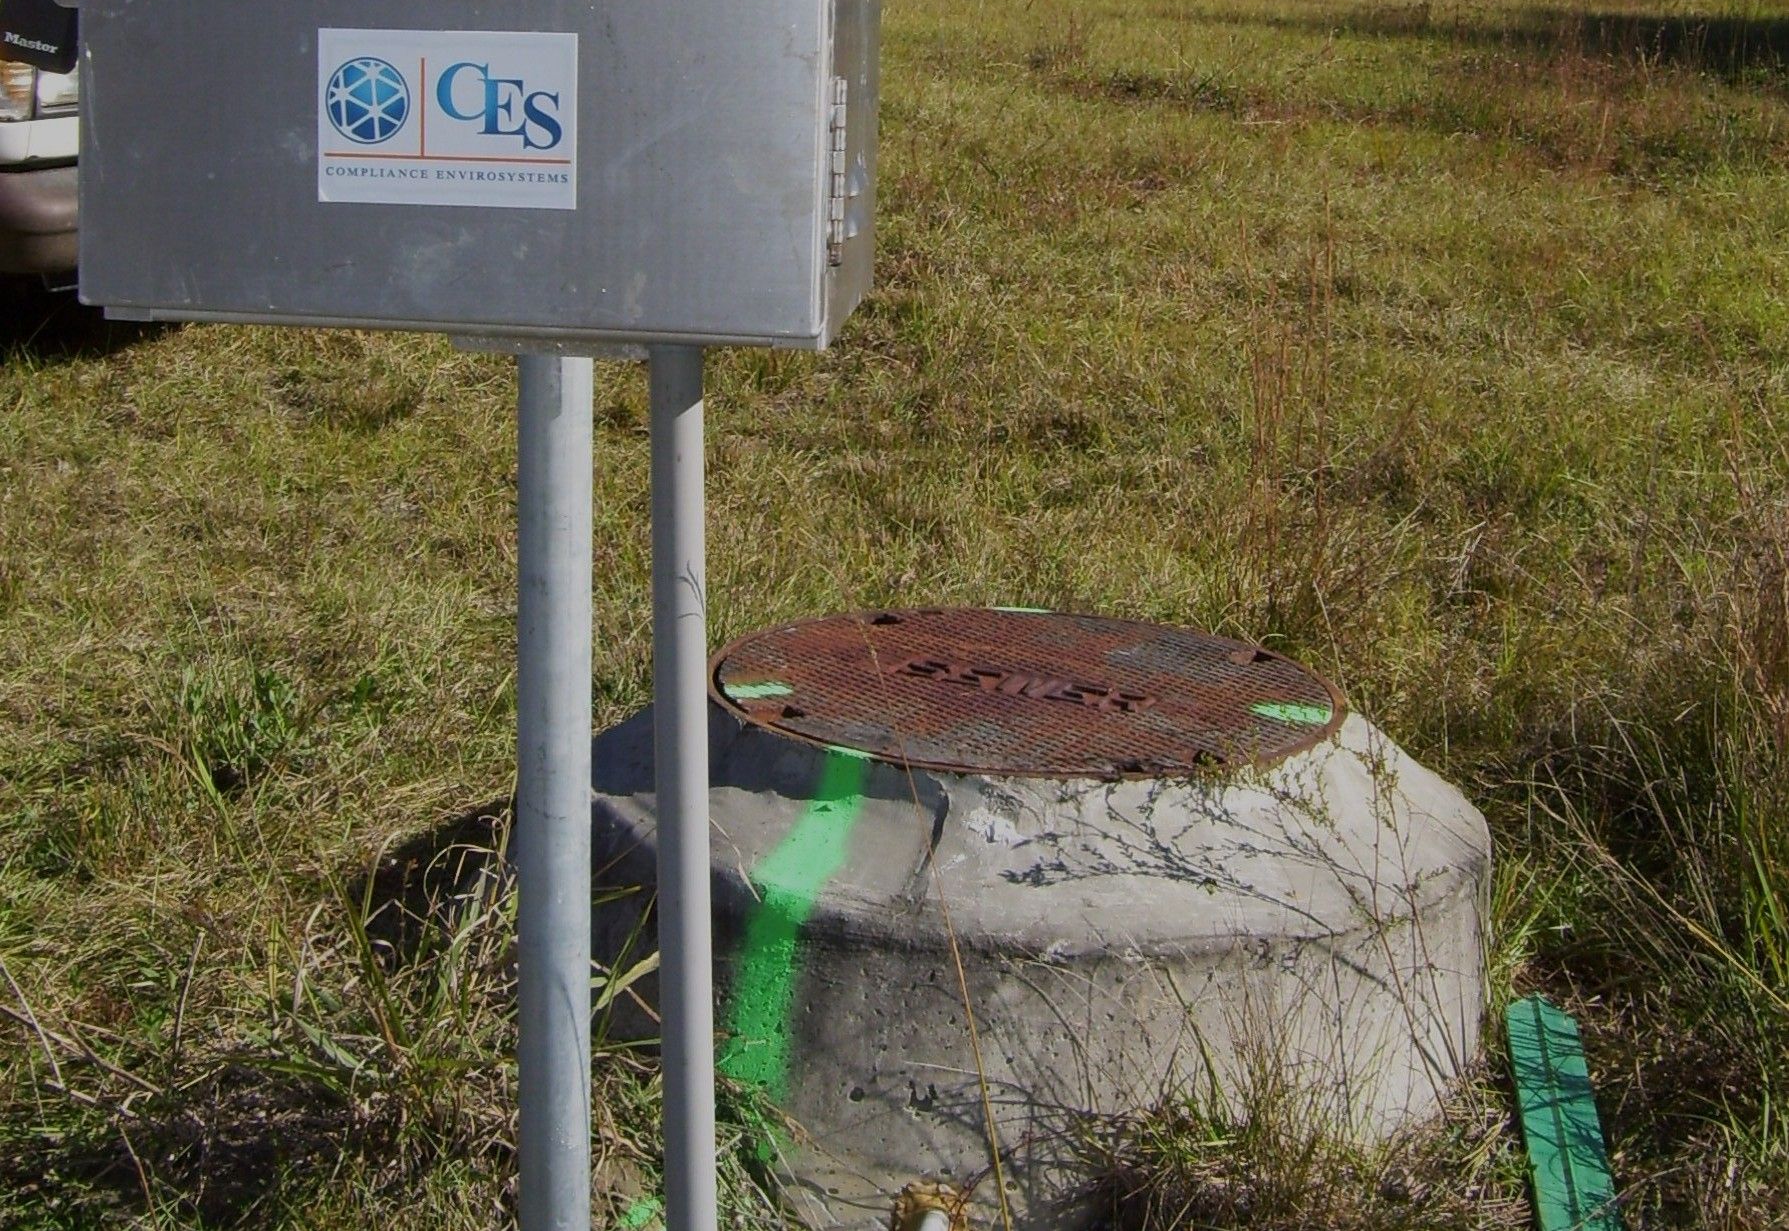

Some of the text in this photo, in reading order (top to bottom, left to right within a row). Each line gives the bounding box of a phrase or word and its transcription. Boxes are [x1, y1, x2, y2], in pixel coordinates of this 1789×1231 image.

[436, 62, 562, 150] CES
[325, 166, 568, 184] COMPLIANCE ENVIROSYSTEMS
